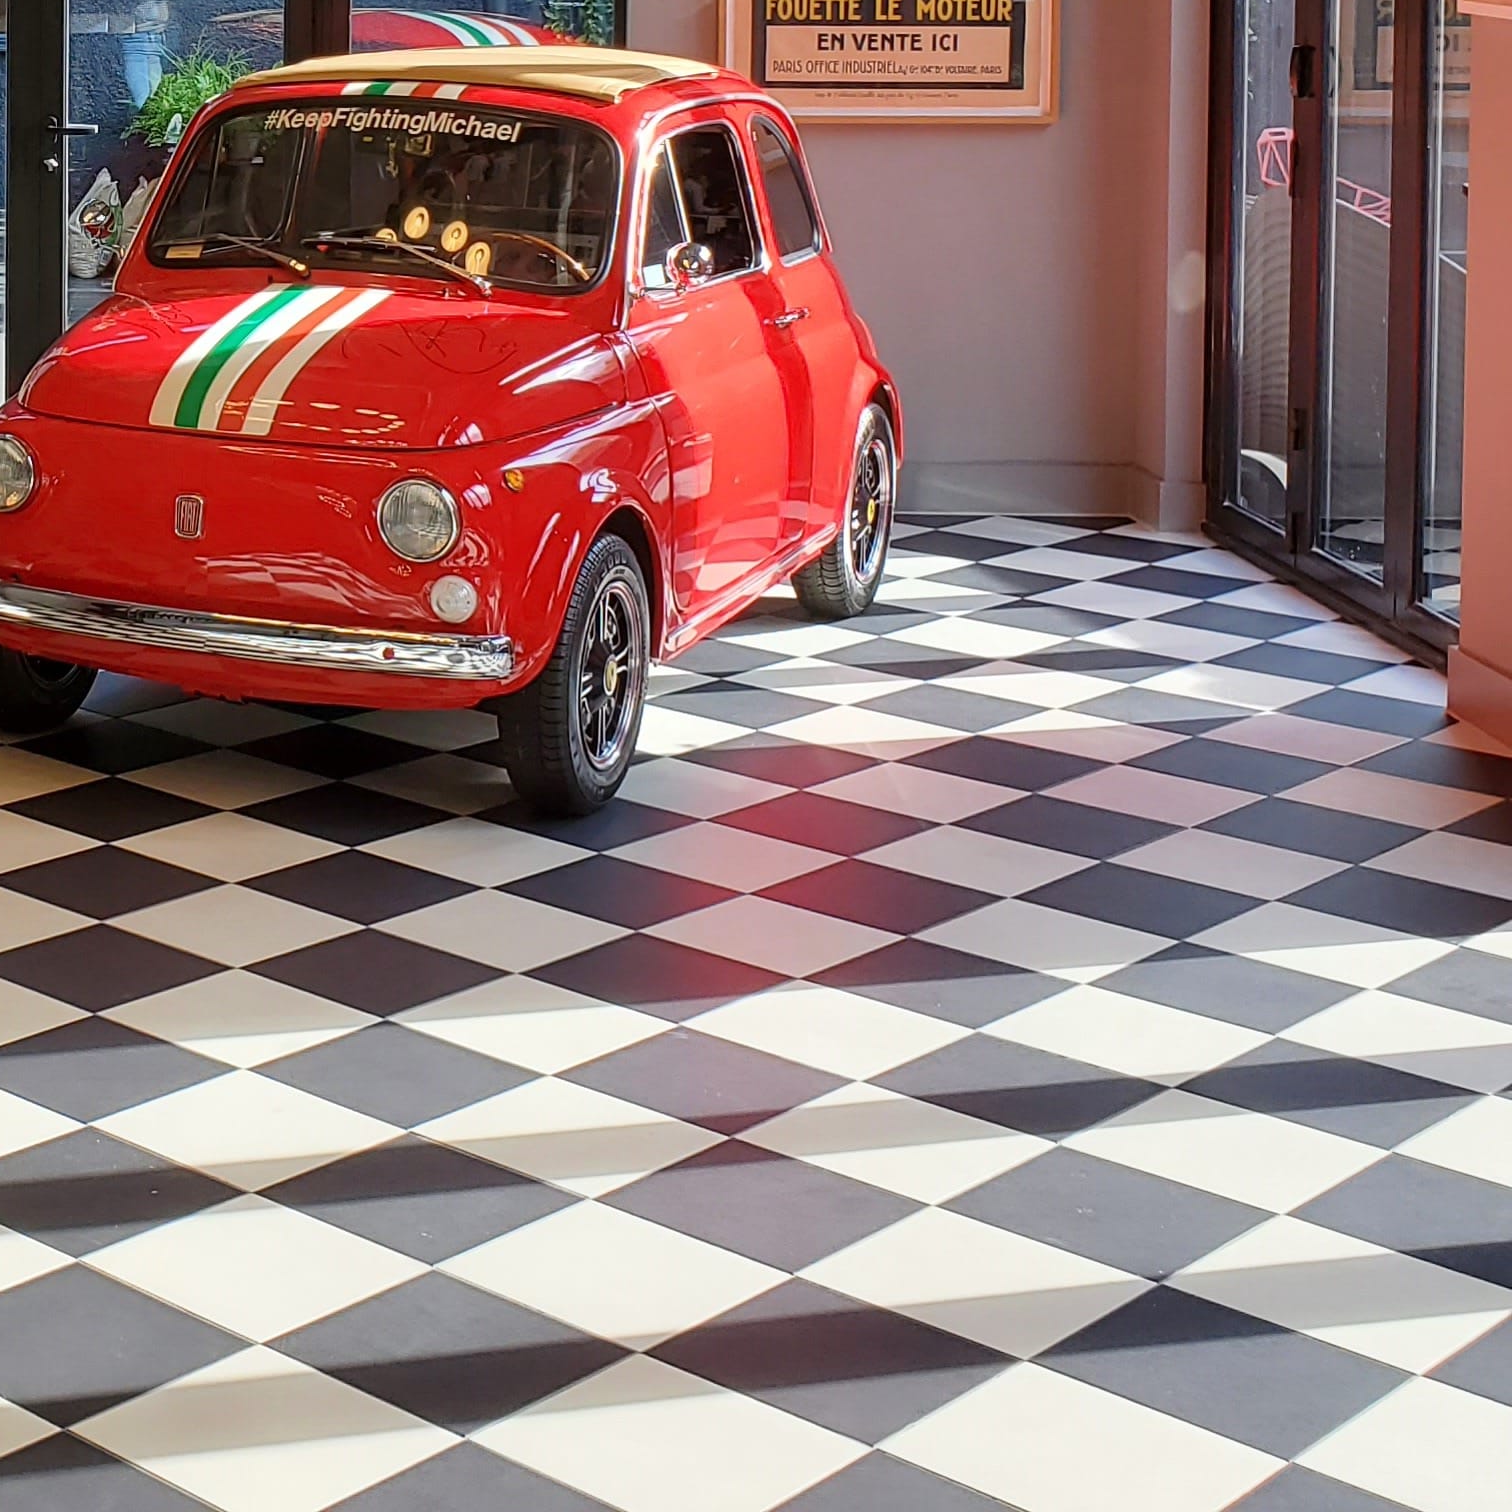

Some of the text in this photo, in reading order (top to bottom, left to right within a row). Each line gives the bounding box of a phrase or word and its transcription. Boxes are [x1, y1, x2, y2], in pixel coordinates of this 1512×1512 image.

[817, 33, 958, 51] EN VENTE ICI
[772, 60, 803, 73] PARIS
[805, 59, 840, 73] OFFICE
[842, 59, 897, 74] INDUSTRIEL
[264, 107, 522, 143] #KeepFightingMichael
